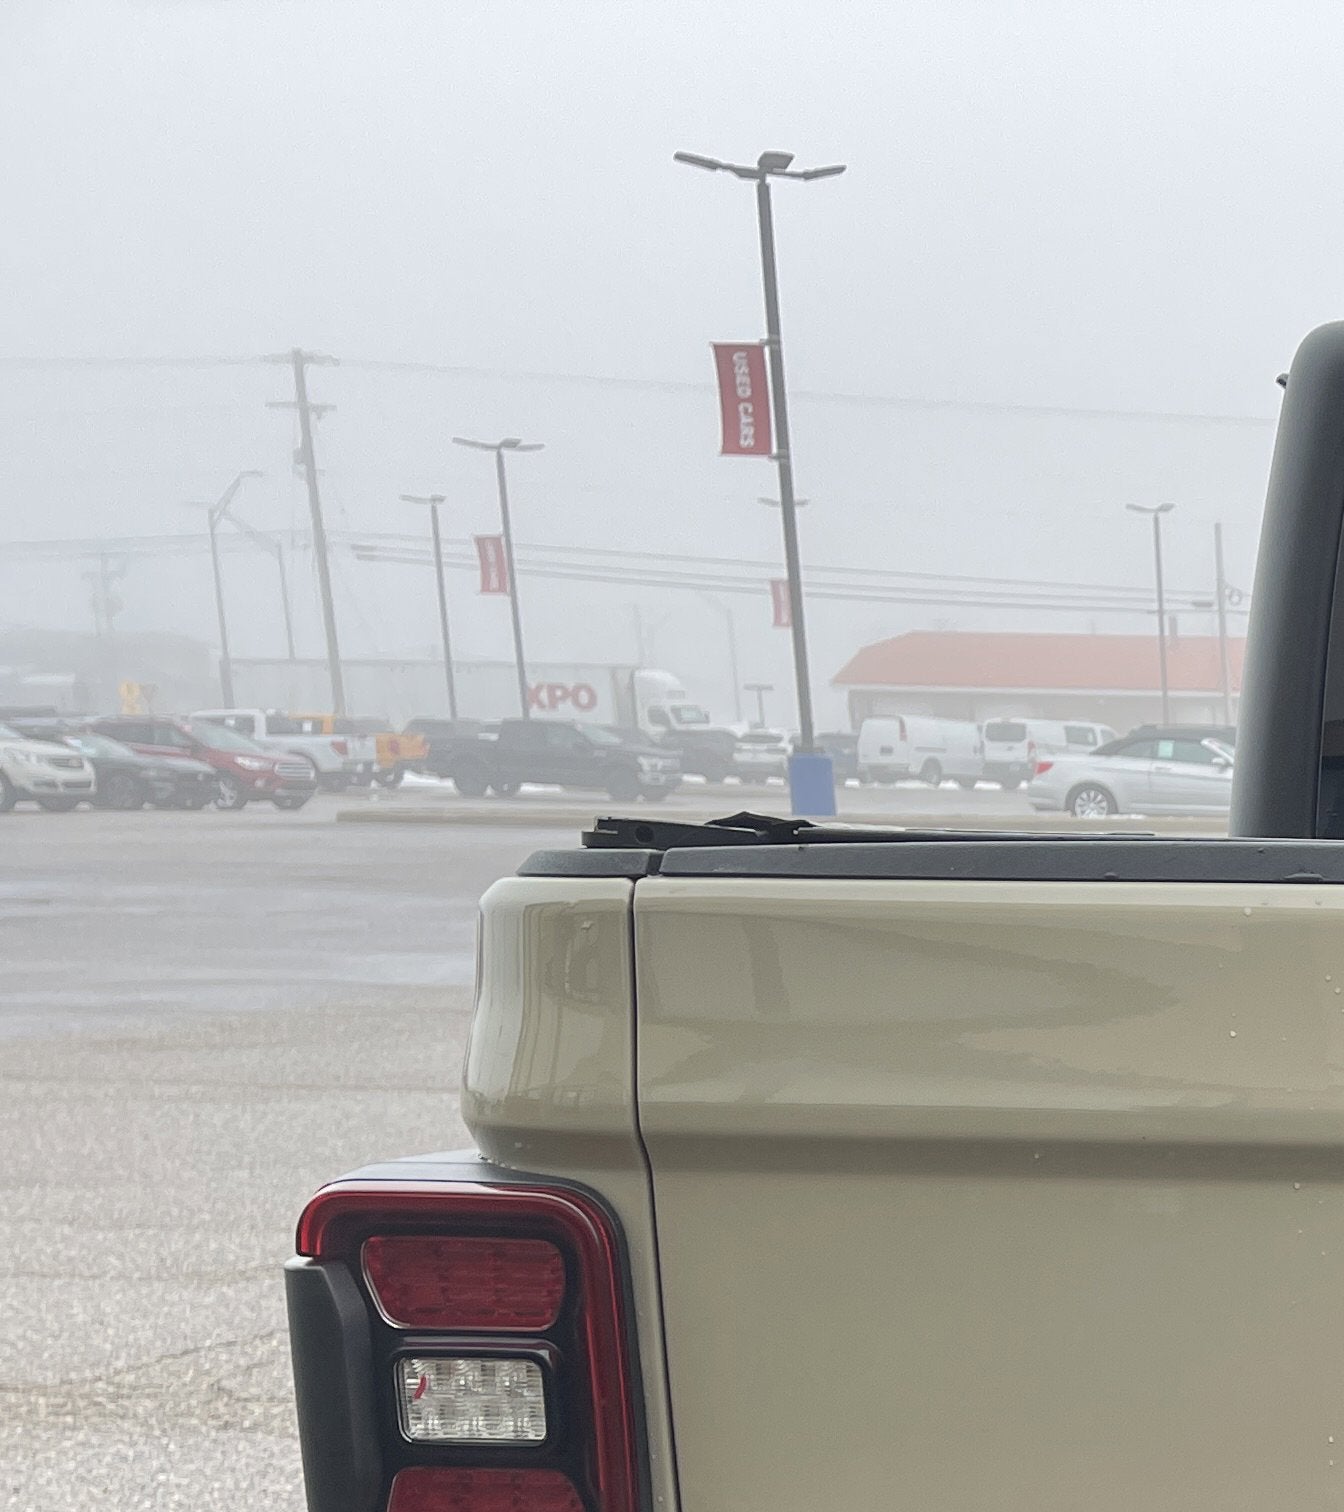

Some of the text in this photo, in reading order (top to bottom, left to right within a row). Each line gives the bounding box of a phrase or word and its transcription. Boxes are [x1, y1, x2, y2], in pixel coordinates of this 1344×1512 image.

[732, 351, 756, 449] USED CARS
[526, 683, 598, 712] XPO
